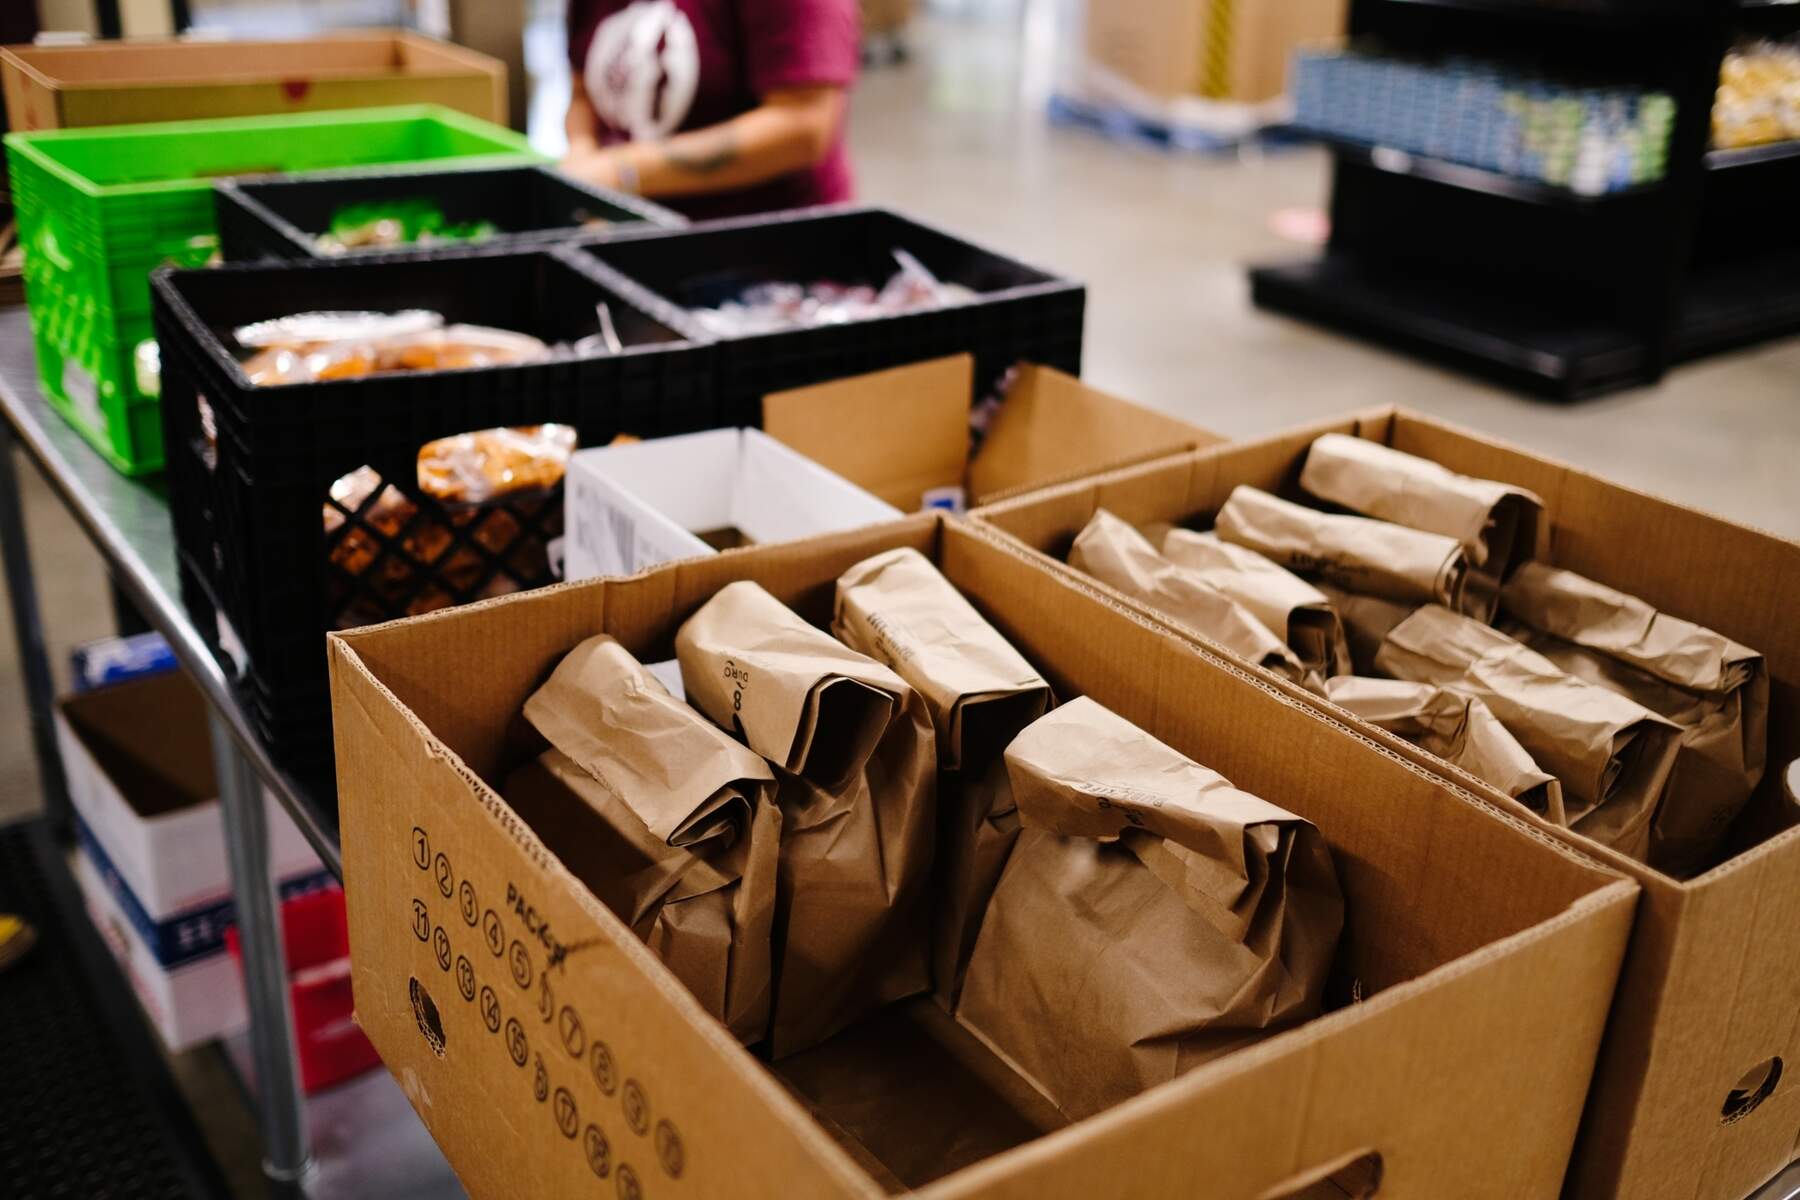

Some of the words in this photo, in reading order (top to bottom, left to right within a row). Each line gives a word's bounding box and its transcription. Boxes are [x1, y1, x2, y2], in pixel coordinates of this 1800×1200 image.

[723, 665, 749, 683] DURO
[733, 689, 742, 712] 8
[413, 902, 428, 939] 11
[436, 930, 450, 969] 12
[459, 960, 474, 998] 13
[483, 991, 499, 1029] 14
[509, 1023, 527, 1064] 15
[557, 1094, 577, 1134] 17
